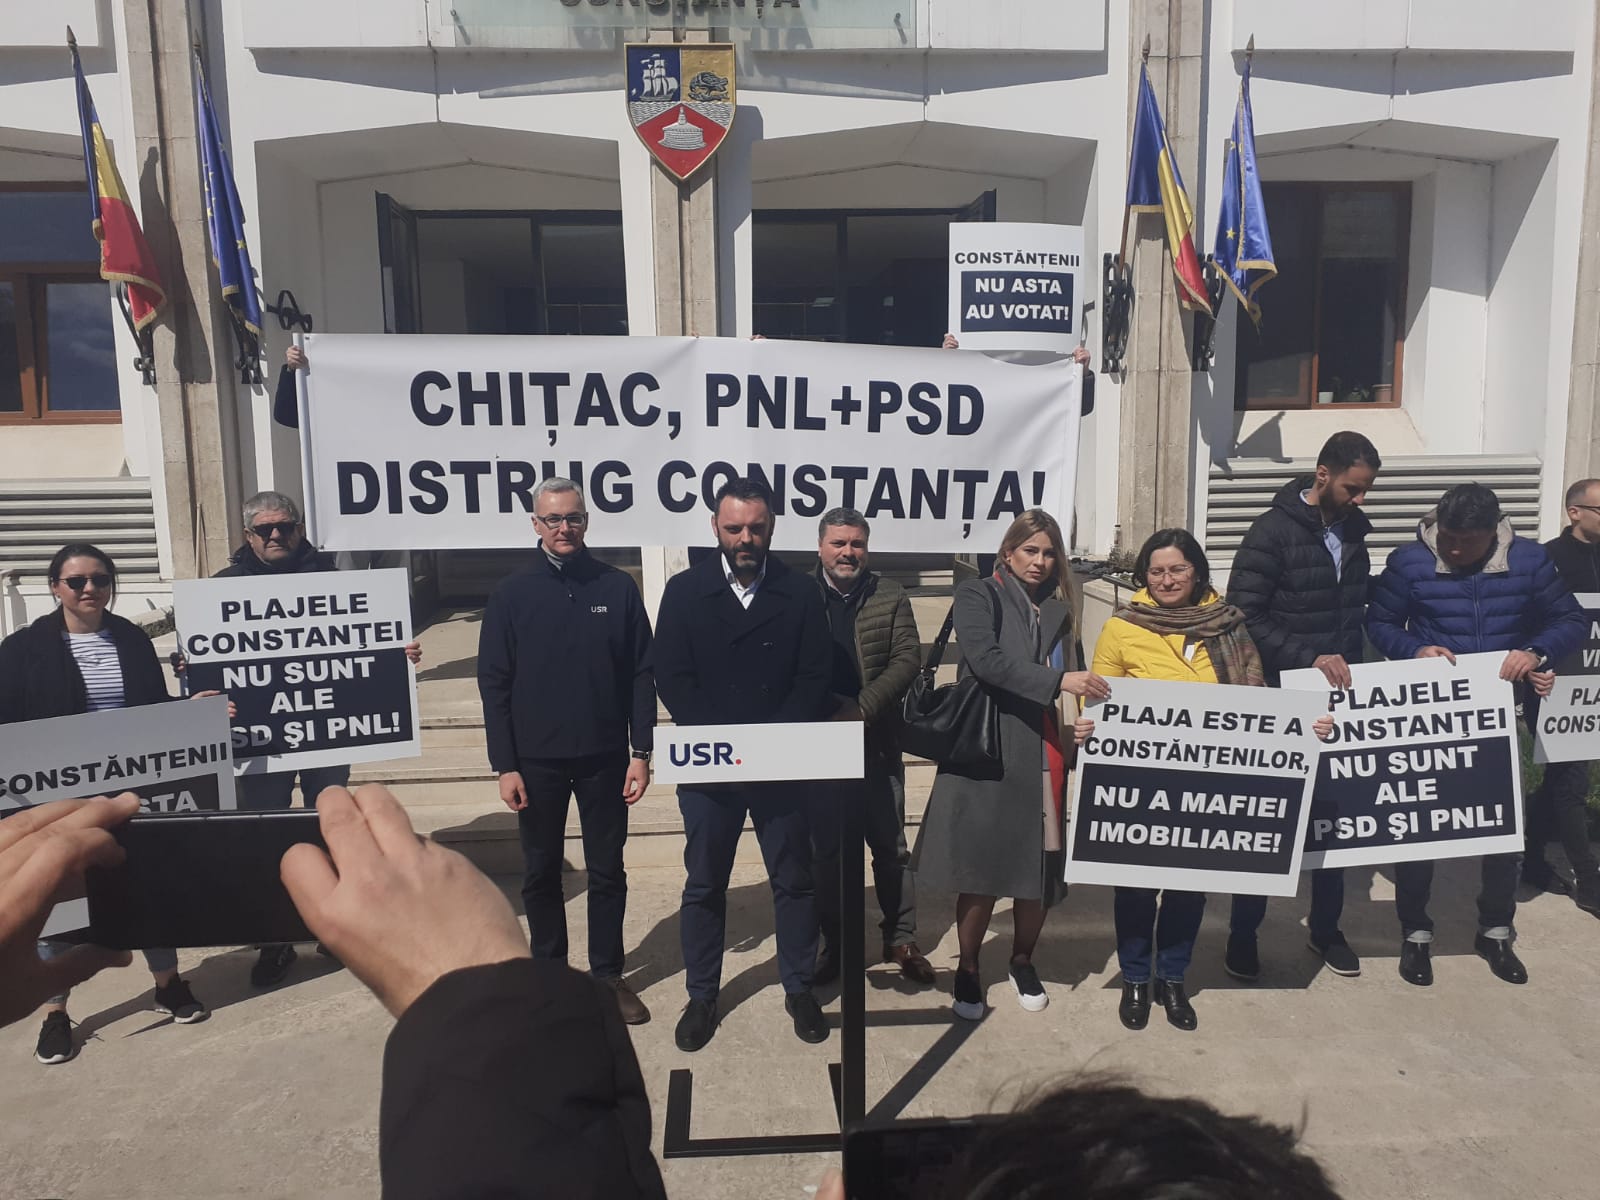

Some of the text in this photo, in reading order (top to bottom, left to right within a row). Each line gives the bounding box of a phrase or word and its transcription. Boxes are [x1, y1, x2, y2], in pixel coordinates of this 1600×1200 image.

[955, 250, 1080, 268] CONSTĂNȚENII
[975, 278, 1062, 294] NU ASTA
[966, 304, 1069, 320] AU VOTAT!
[410, 370, 985, 447] CHIȚAC, PNL+PSD
[221, 593, 369, 622] PLAJELE
[223, 656, 375, 689] NU SUNT
[270, 688, 335, 714] ALE
[1328, 678, 1472, 713] PLAJELE
[231, 724, 272, 749] SD
[327, 712, 400, 739] PNL!
[1102, 703, 1303, 736] PLAJA ESTE A
[1321, 707, 1507, 744] ONSTANŢEI
[1330, 745, 1478, 780] NU SUNT
[138, 791, 198, 814] STA
[1094, 785, 1288, 819] NU A MAFIEI
[1375, 778, 1438, 806] ALE
[1089, 820, 1282, 854] IMOBILIARE!
[1313, 815, 1377, 841] PSD
[1431, 804, 1504, 831] PNL!
